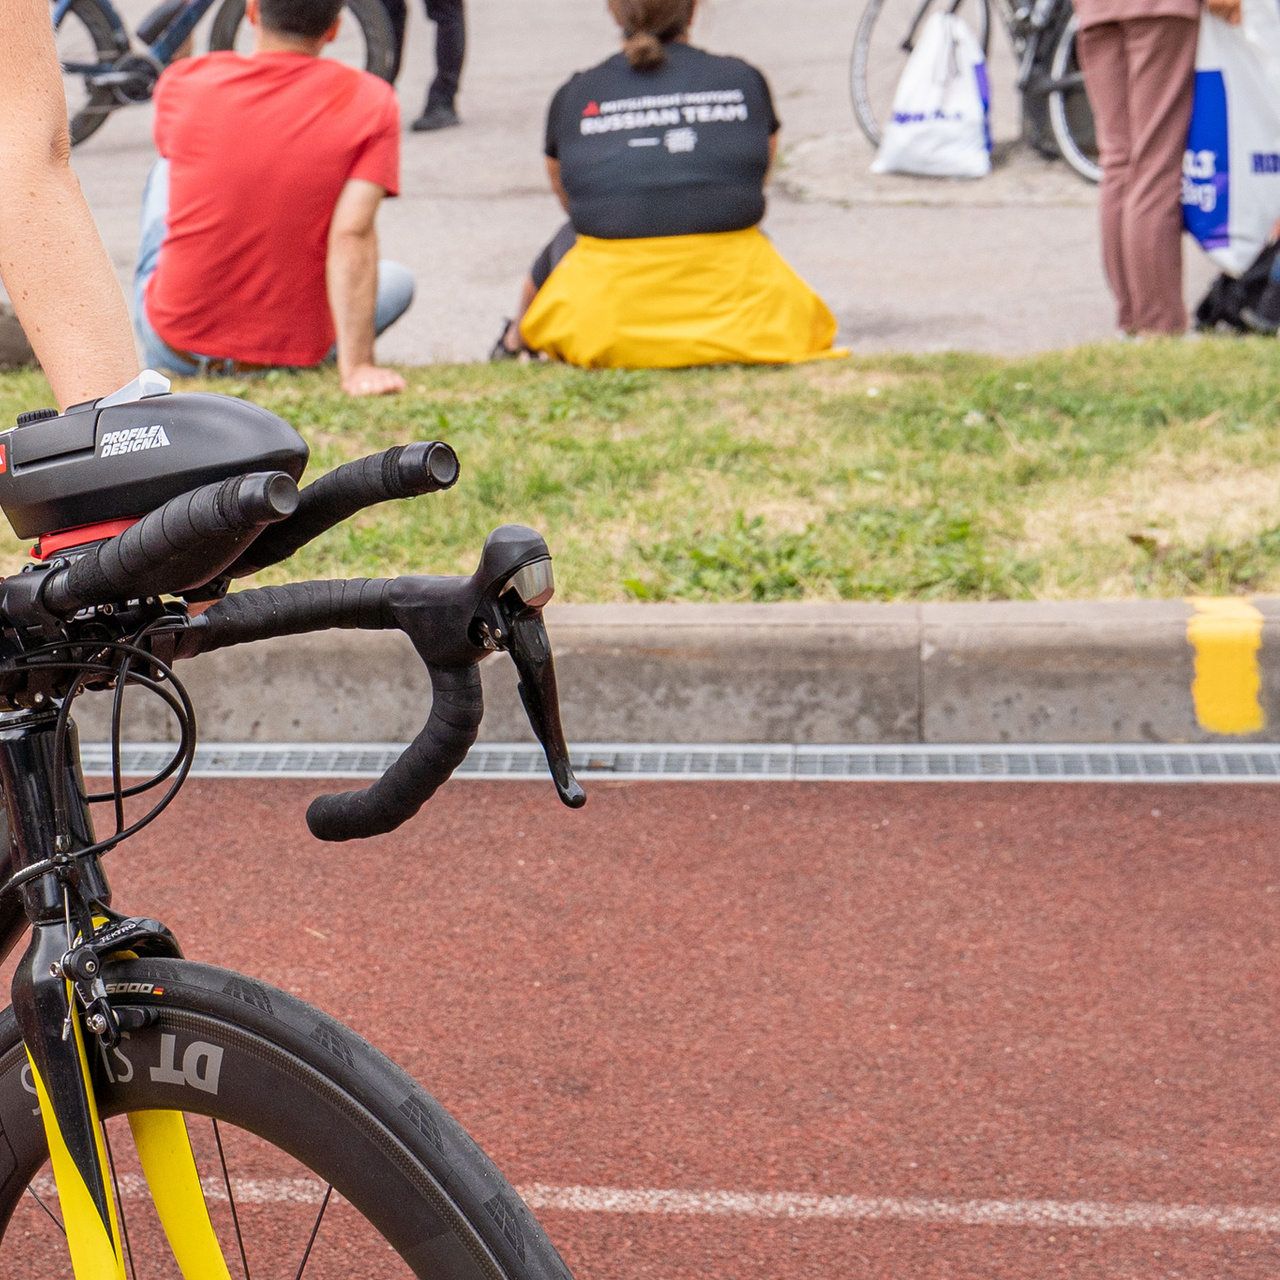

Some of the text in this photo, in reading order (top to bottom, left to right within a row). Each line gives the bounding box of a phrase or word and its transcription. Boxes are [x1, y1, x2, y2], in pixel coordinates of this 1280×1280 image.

[580, 103, 748, 136] RUSSIAN TEAM
[100, 425, 161, 447] PROFILE
[100, 437, 154, 459] DESIGN
[100, 922, 138, 943] TEKTRO
[105, 982, 155, 995] 5000
[149, 1033, 225, 1096] DT
